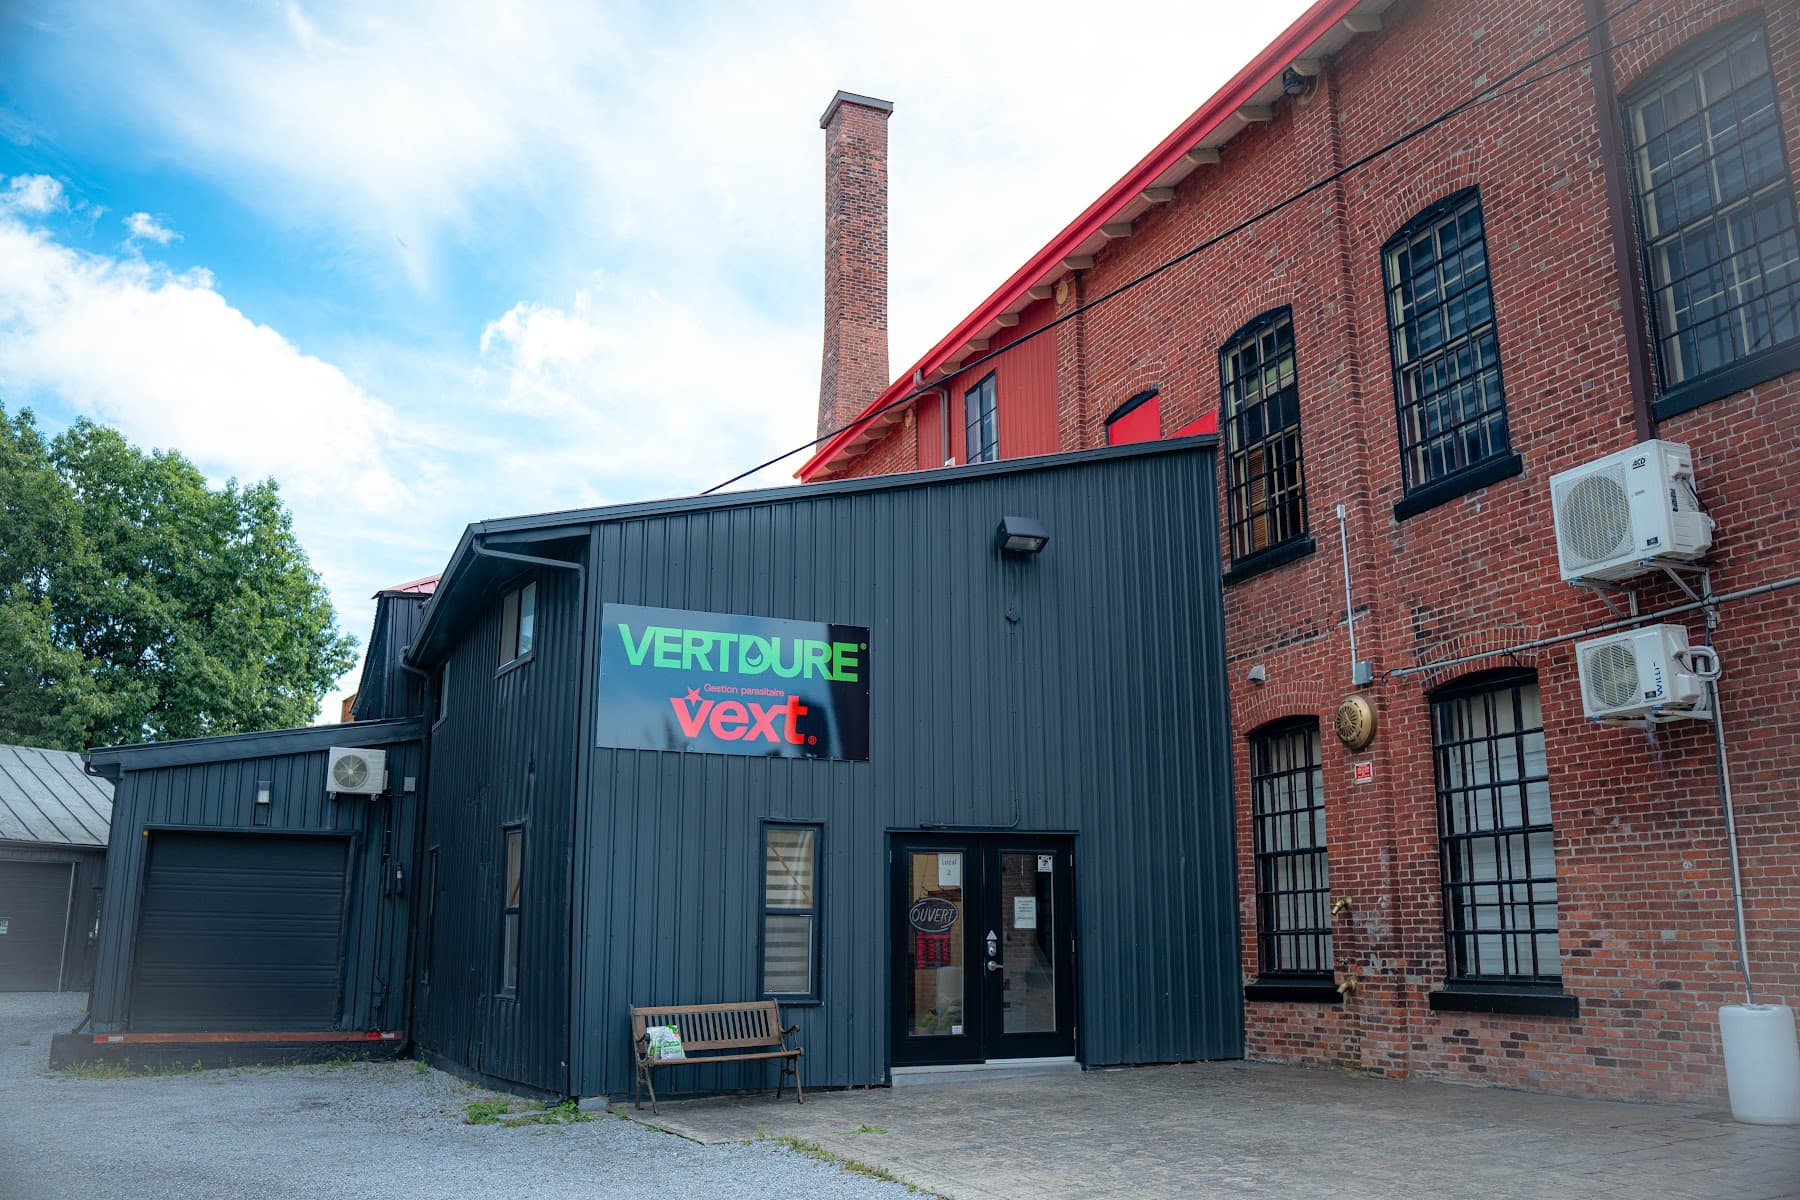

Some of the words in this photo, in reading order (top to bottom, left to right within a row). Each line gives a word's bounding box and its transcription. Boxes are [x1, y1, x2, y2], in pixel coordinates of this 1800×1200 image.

[703, 683, 739, 694] Gestion
[741, 686, 785, 697] parasitaire
[911, 907, 955, 923] OUVERT
